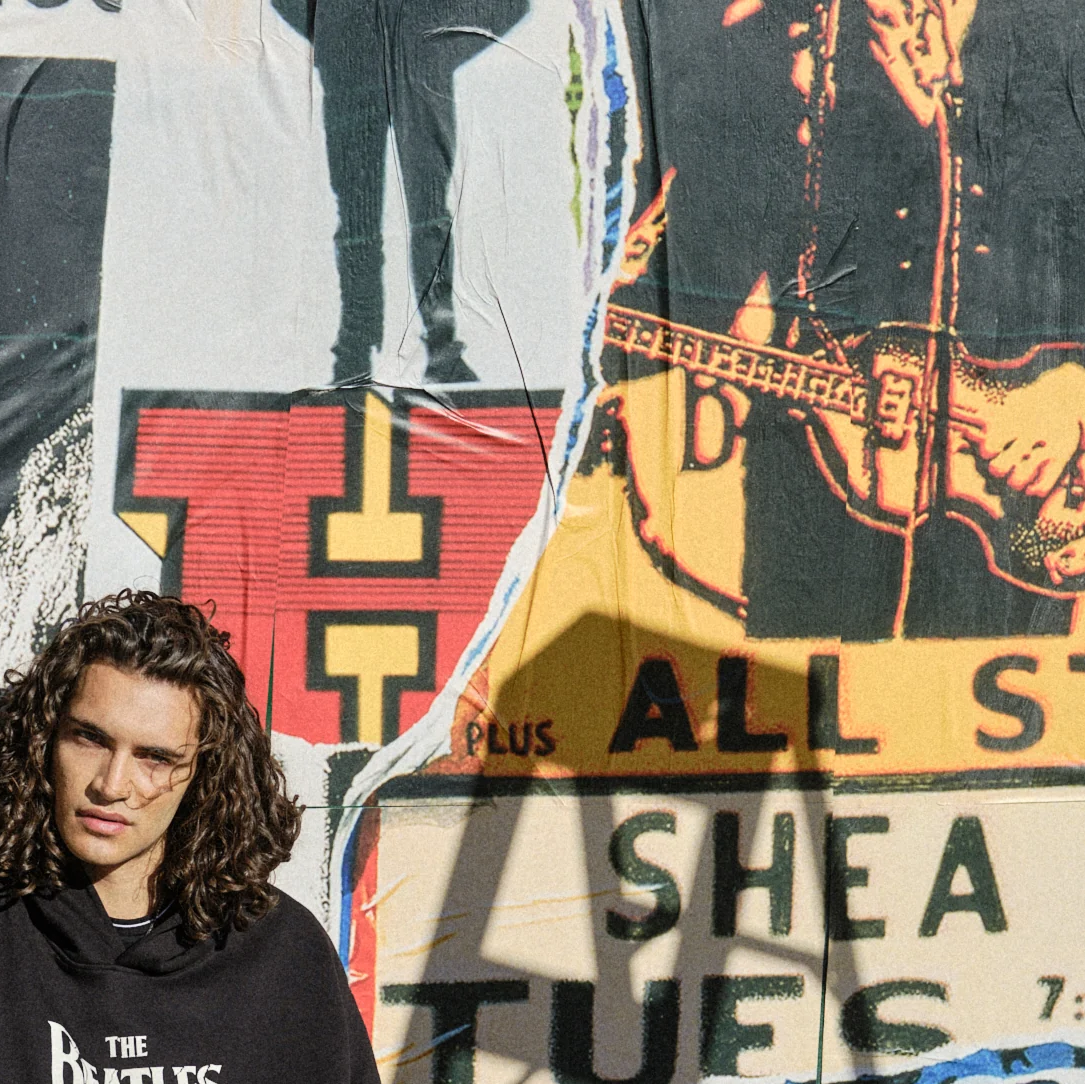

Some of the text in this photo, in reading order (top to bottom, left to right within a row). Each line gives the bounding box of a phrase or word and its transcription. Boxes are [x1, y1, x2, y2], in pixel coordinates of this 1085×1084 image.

[465, 653, 1085, 757] PLUS ALL S
[606, 809, 1009, 942] SHEA
[105, 1035, 149, 1058] THE
